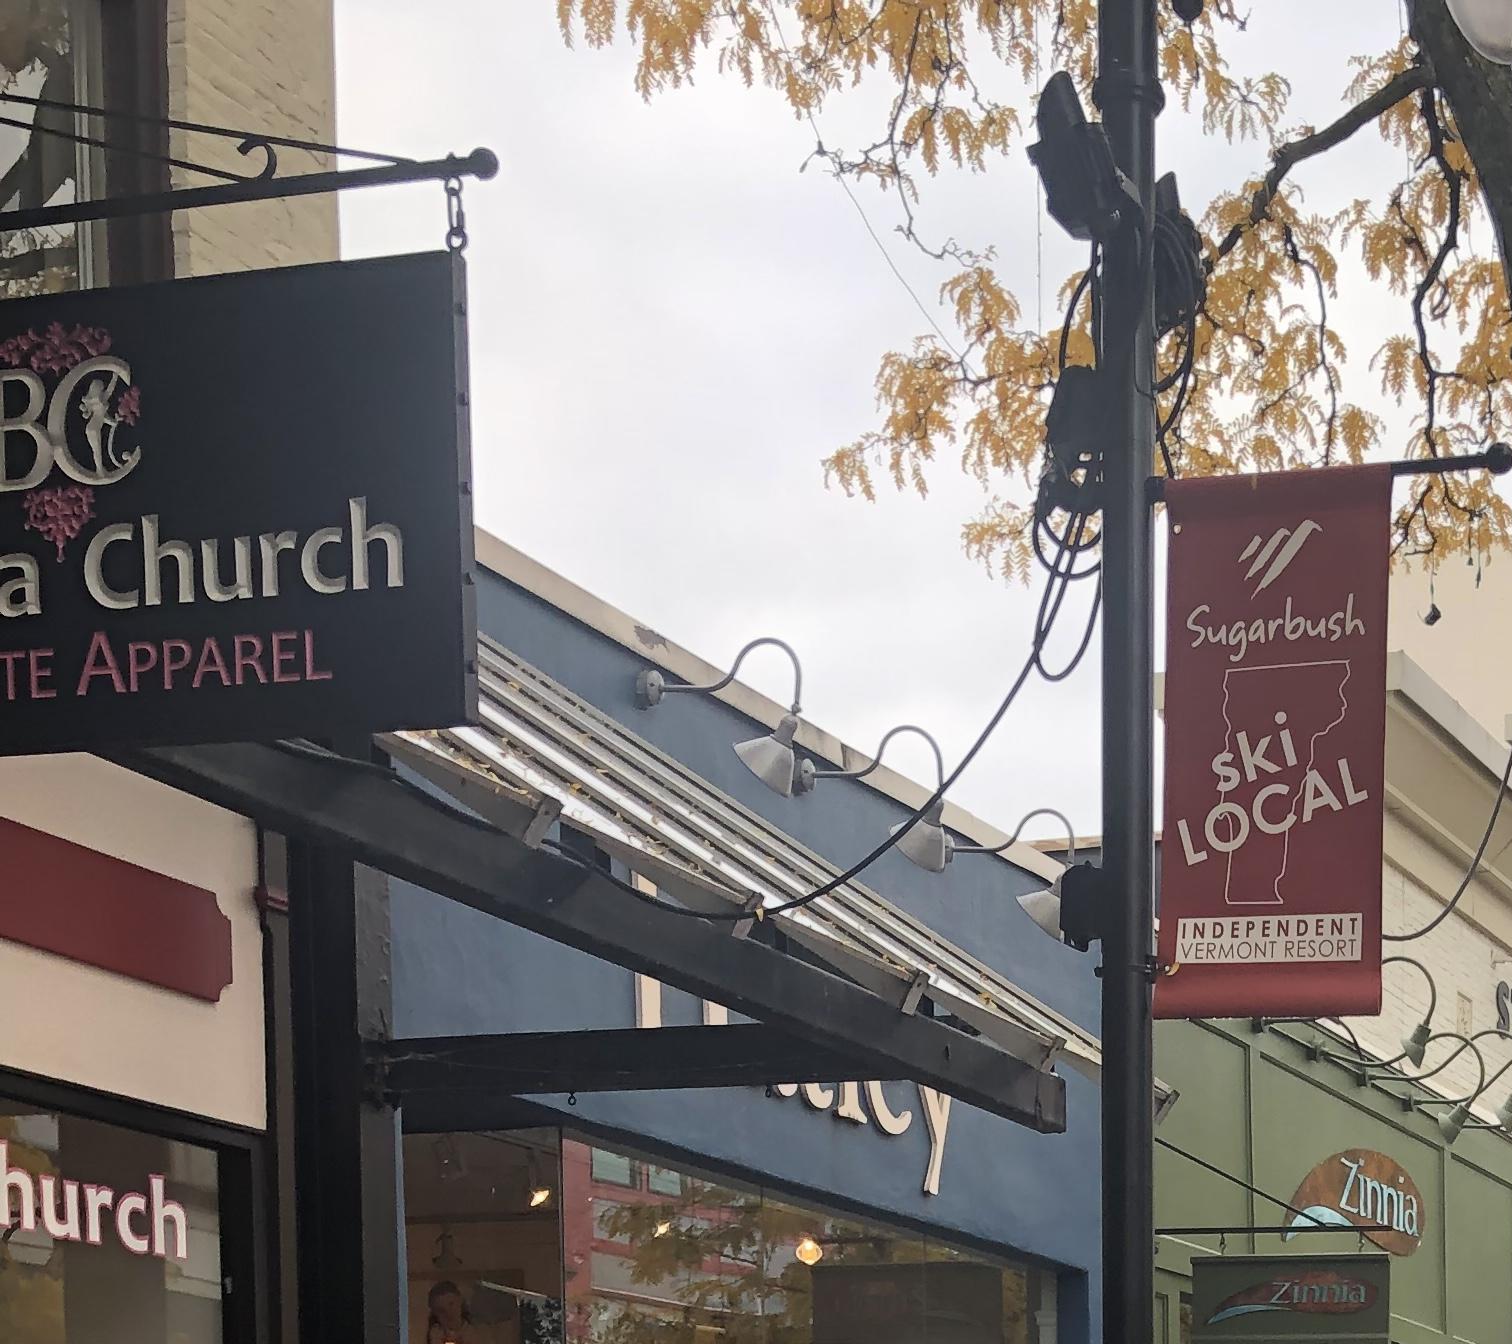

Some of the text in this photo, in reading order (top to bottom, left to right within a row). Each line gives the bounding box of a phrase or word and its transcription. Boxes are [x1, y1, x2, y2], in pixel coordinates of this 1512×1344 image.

[84, 497, 404, 610] Church
[1186, 593, 1366, 662] Sugarbush
[77, 630, 333, 697] APPAREL
[1177, 758, 1369, 866] LOCAL
[1181, 918, 1358, 940] INDEPENDENT
[1181, 938, 1357, 960] VERMONT RESORT
[1340, 1157, 1420, 1237] Zinnia
[1270, 1279, 1368, 1304] Zinnia
